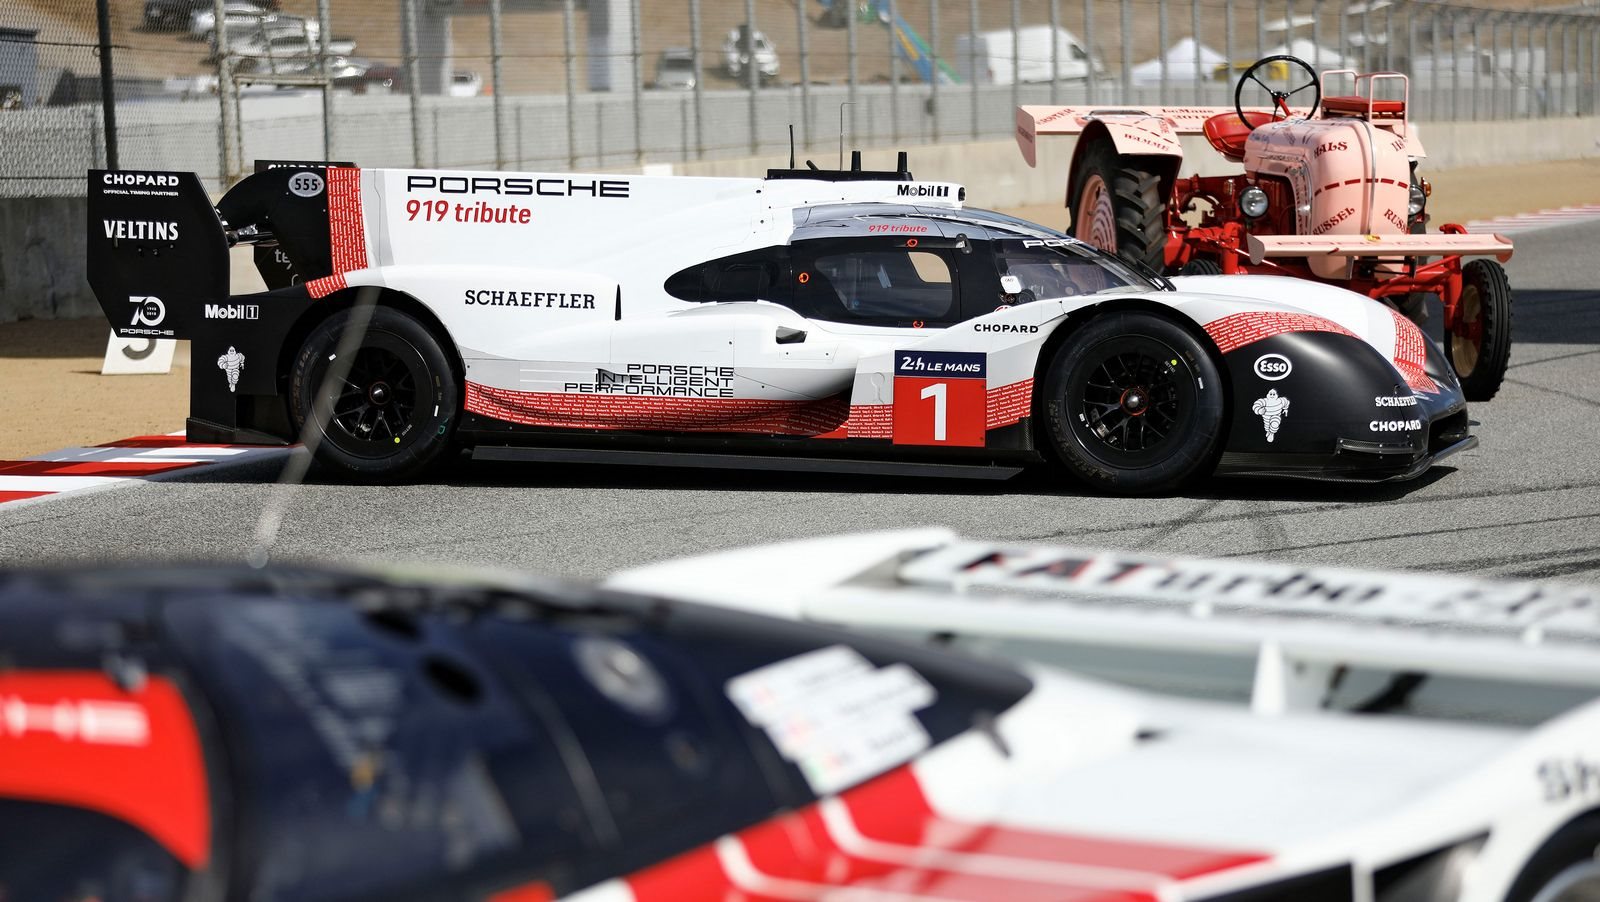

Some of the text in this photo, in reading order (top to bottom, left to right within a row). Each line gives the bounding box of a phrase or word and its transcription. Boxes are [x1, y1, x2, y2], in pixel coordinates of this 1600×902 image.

[103, 173, 179, 187] CHOPARD
[294, 178, 318, 191] 555
[407, 175, 630, 198] PORSCHE
[897, 184, 934, 197] Mobil
[406, 199, 532, 224] 919 tribute
[103, 219, 179, 241] VELTINS
[868, 224, 928, 233] 919 tribute
[464, 289, 596, 309] SCHAEFFLER
[128, 296, 166, 327] 70
[205, 304, 244, 319] Mobil
[120, 328, 175, 336] PORSCHE
[973, 323, 1040, 334] CHOPARD
[627, 363, 734, 377] PORSCHE
[900, 356, 981, 372] 24h LE MANS
[1259, 360, 1287, 373] Esso
[594, 372, 734, 388] INTELLIGENT
[564, 382, 734, 398] PERFORMANCE
[920, 382, 947, 441] 1
[1369, 420, 1421, 432] CHOPARD
